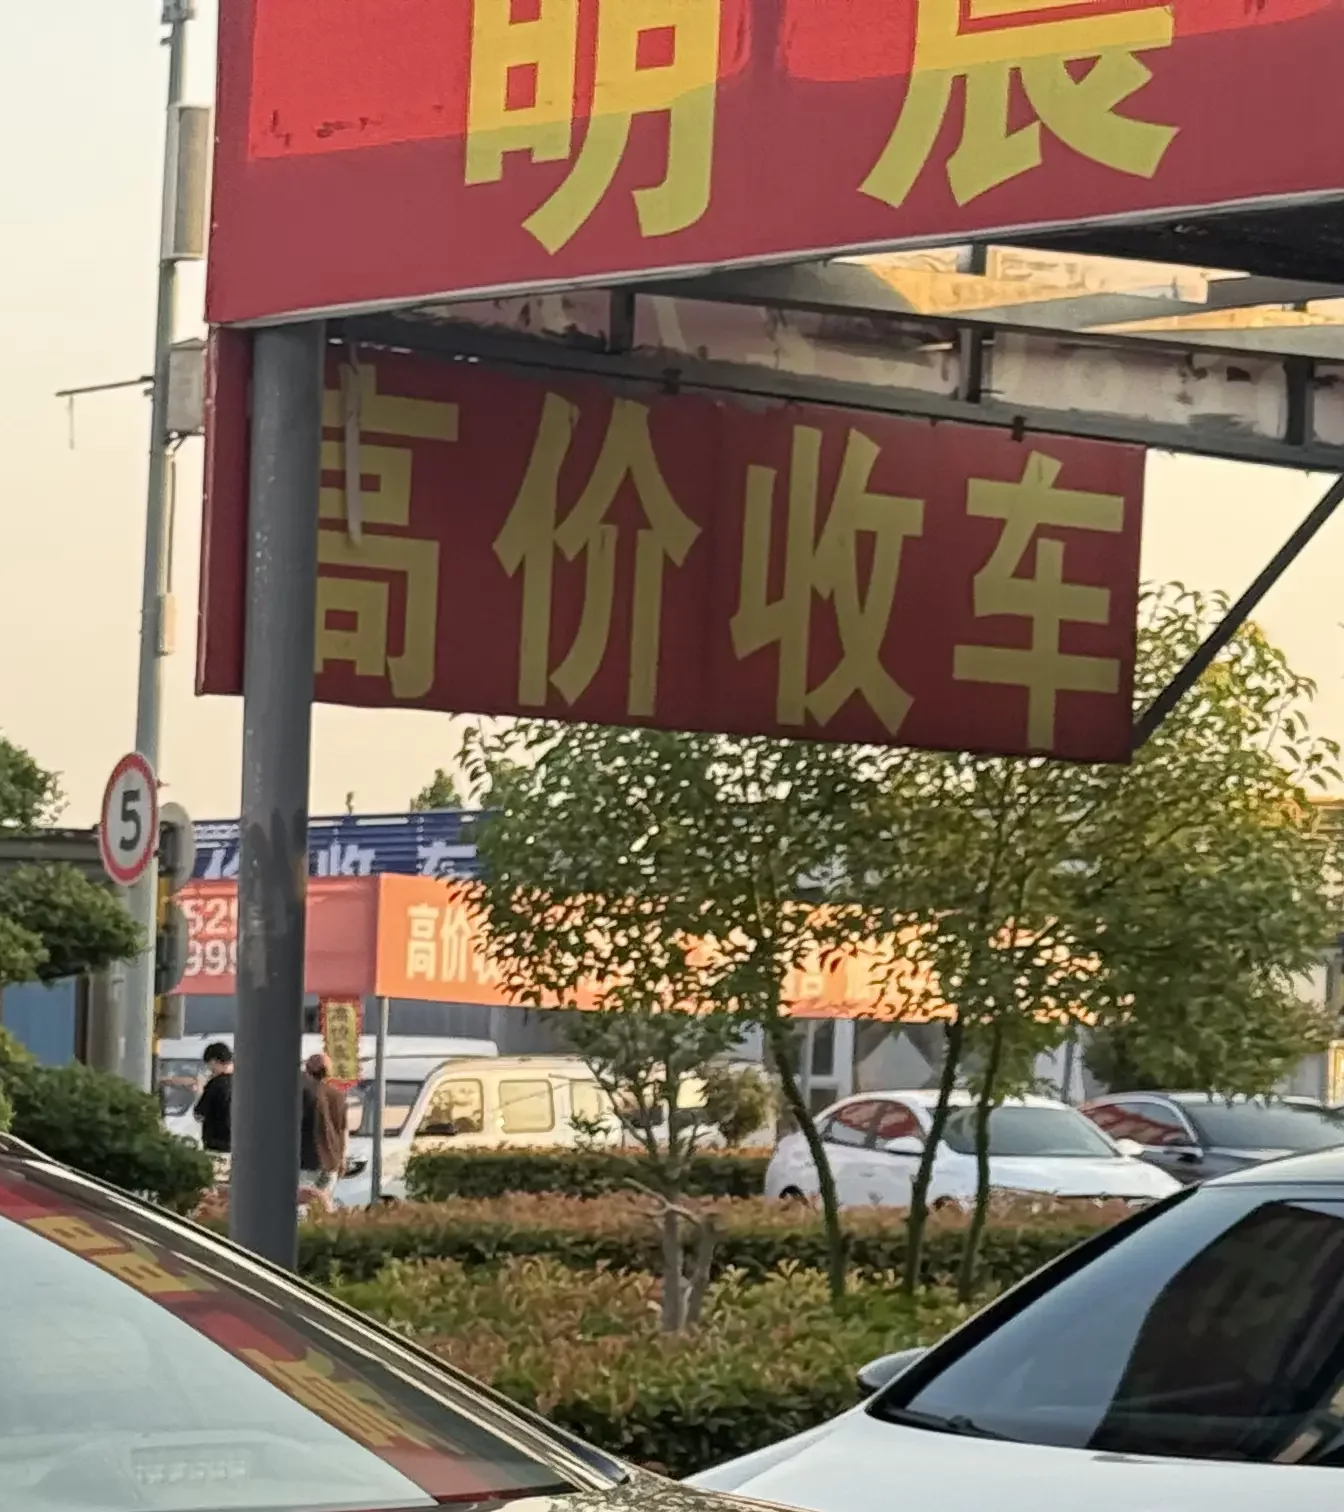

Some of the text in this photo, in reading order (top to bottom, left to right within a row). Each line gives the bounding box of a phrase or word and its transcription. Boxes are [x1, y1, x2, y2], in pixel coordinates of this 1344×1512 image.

[314, 362, 1126, 752] 高价收车
[119, 788, 141, 852] 5
